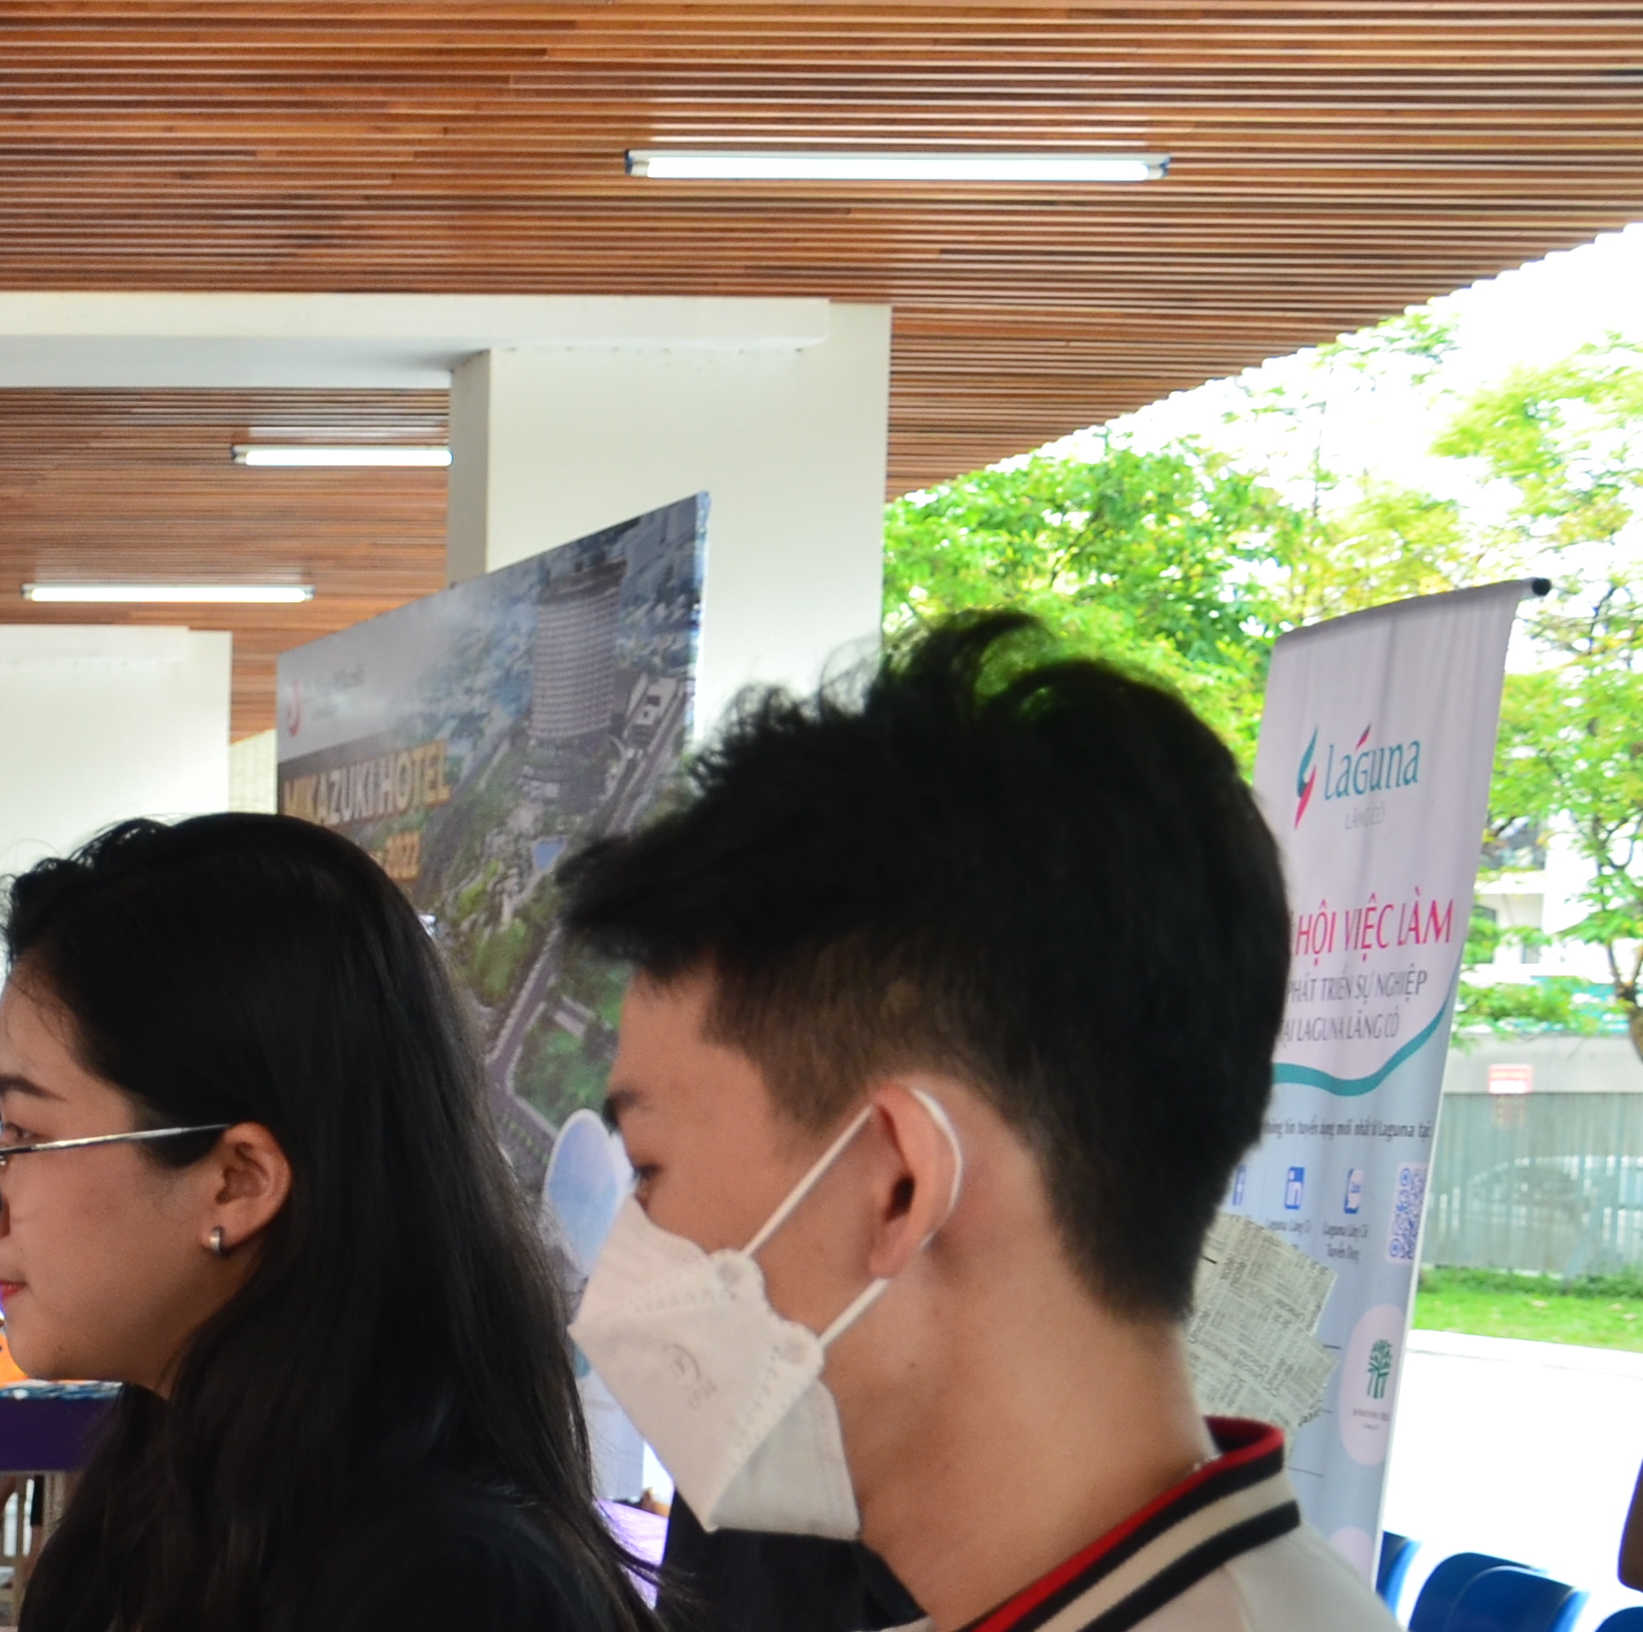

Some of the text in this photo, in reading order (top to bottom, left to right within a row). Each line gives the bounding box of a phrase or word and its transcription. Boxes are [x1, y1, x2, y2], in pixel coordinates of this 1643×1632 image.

[377, 738, 451, 816] HOTEL
[1295, 886, 1454, 966] HỘI VIỆC LÀM
[1378, 1121, 1415, 1142] Laguna
